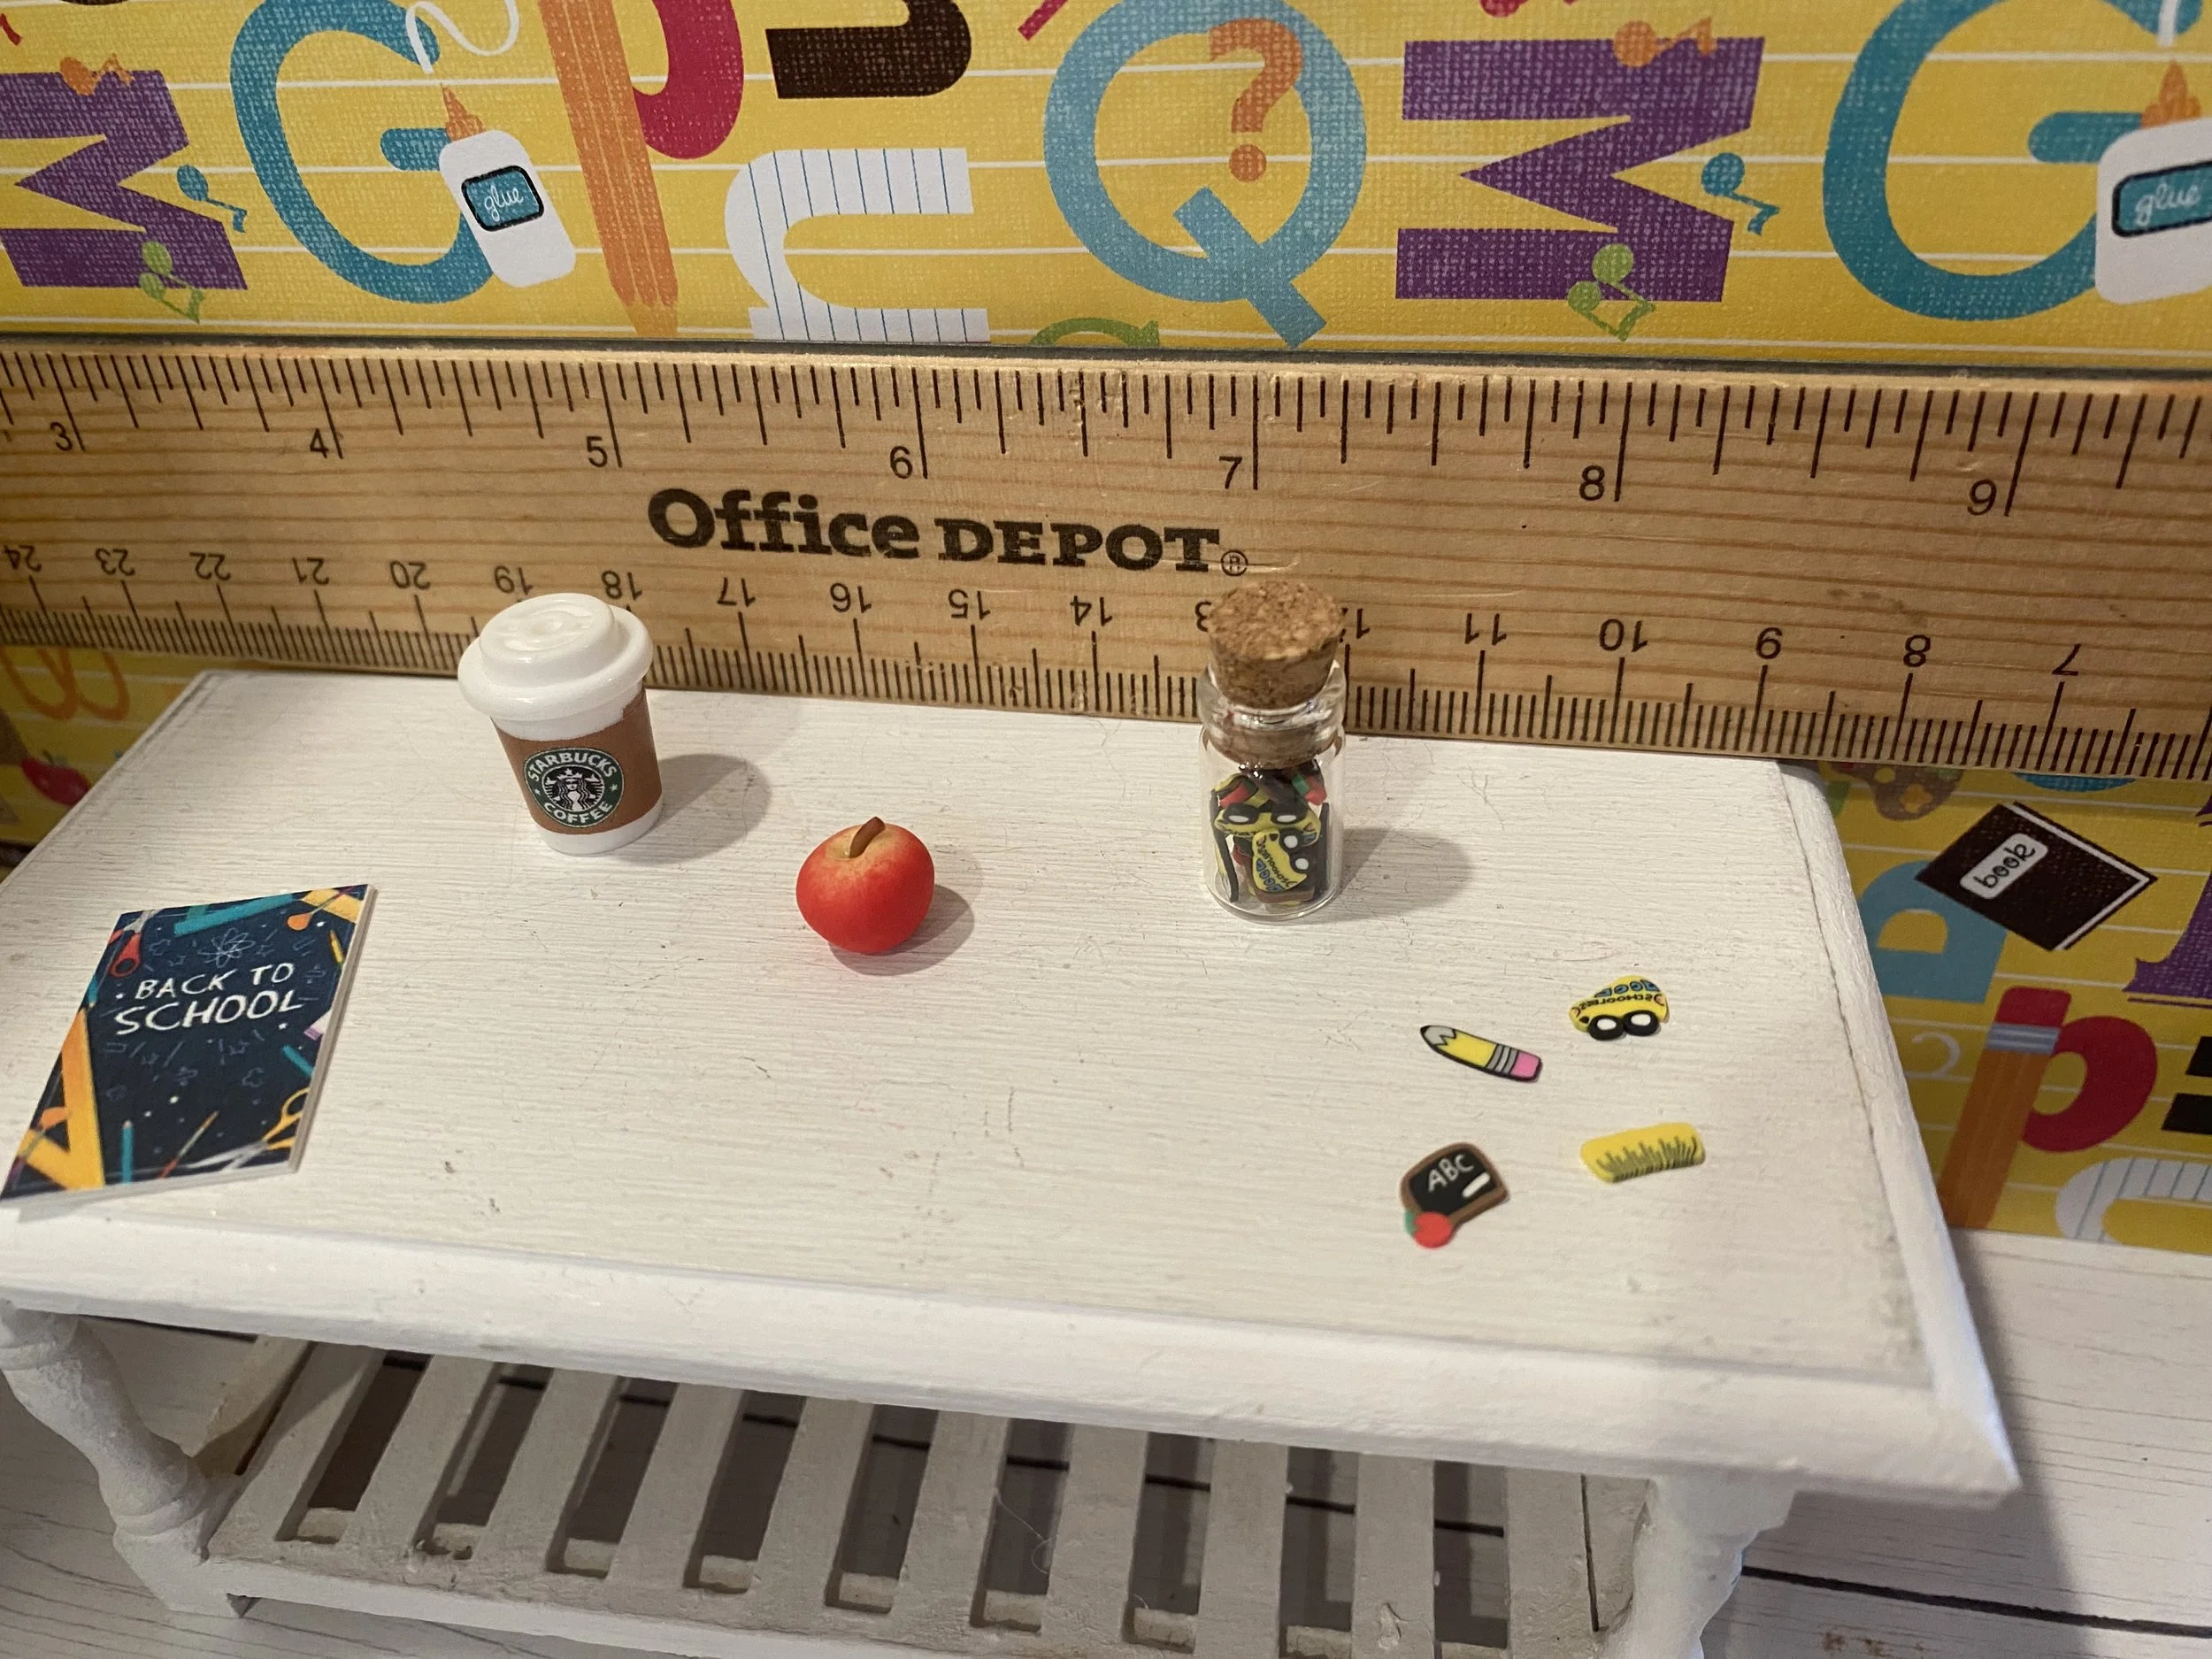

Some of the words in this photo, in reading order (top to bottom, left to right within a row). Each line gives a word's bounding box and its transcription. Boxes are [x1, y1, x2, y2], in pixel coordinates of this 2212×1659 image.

[484, 184, 524, 222] glue
[2135, 182, 2201, 227] glue
[50, 422, 73, 451] 3
[310, 428, 329, 458] 4
[587, 436, 608, 467] 5
[890, 446, 913, 479] 6
[1219, 456, 1242, 489] 7
[1578, 465, 1605, 501] 8
[1968, 479, 1997, 515] 9
[648, 488, 920, 559] Office
[4, 545, 42, 572] 24
[95, 549, 135, 576] 23
[189, 552, 231, 581] 22
[291, 557, 329, 586] 21
[389, 560, 431, 590] 20
[494, 565, 533, 595] 19
[602, 570, 642, 600] 18
[717, 577, 756, 607] 17
[830, 583, 872, 613] 16
[949, 589, 991, 620] 15
[1070, 595, 1112, 626] 14
[1465, 613, 1508, 646] 11
[1599, 618, 1648, 652] 10
[1903, 634, 1931, 667] 8
[2051, 643, 2081, 676] 7
[527, 752, 618, 781] STARBUCKS
[544, 801, 612, 824] COFFEE
[1973, 842, 2036, 888] book
[135, 969, 238, 1000] BACK
[250, 963, 295, 986] TO
[114, 989, 303, 1035] SCHOOL
[1427, 1154, 1474, 1192] ABC
